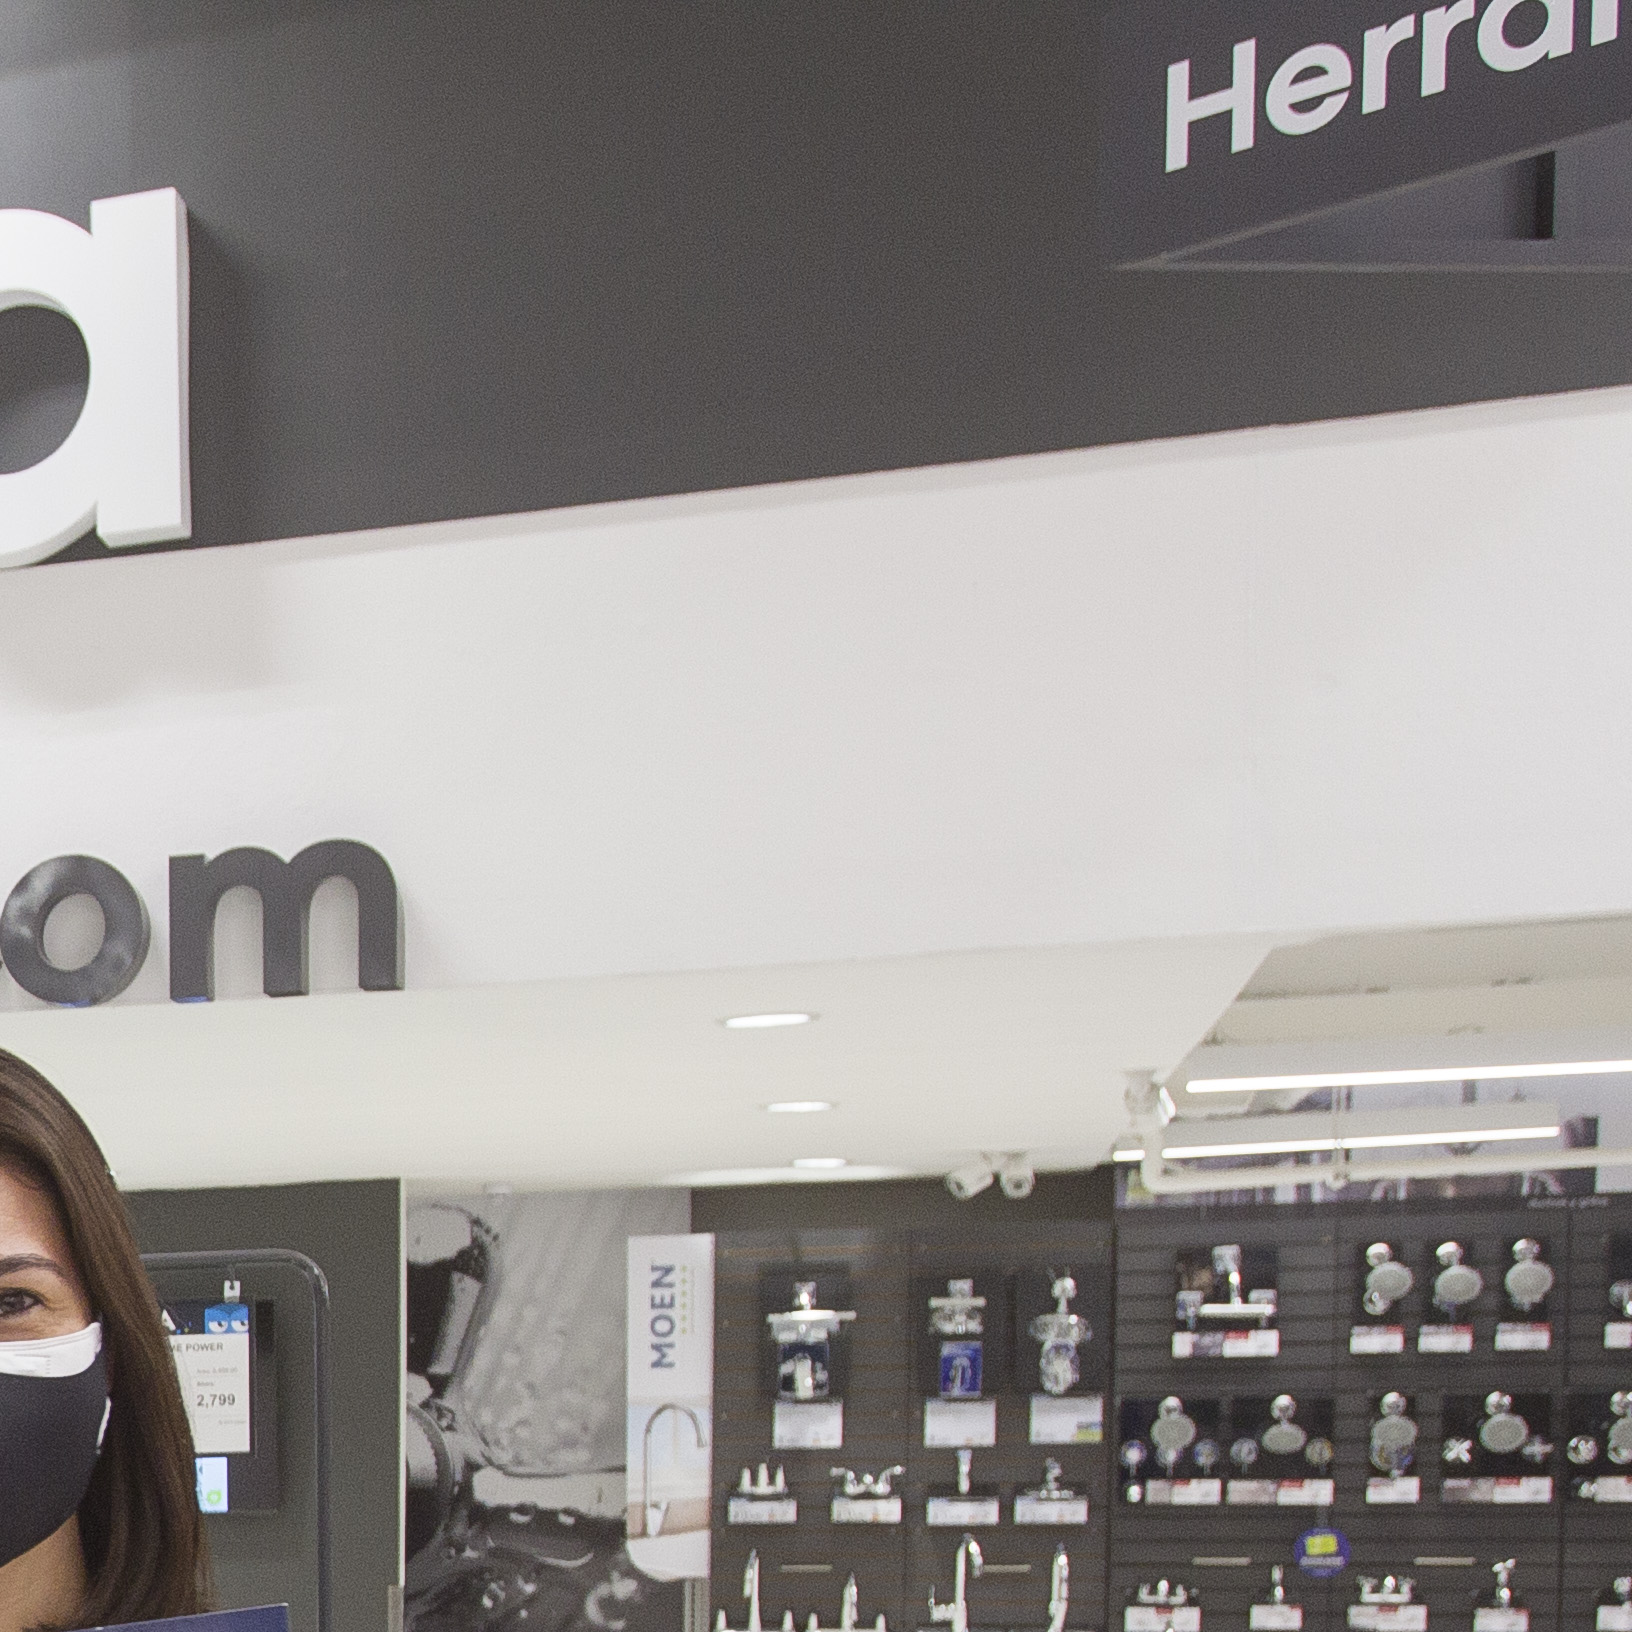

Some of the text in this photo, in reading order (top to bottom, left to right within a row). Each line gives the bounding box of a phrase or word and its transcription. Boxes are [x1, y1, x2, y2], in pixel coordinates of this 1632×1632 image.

[1165, 0, 1618, 173] Herra
[651, 1265, 675, 1368] MOEN
[186, 1342, 223, 1352] POWER
[197, 1394, 235, 1408] 2,799
